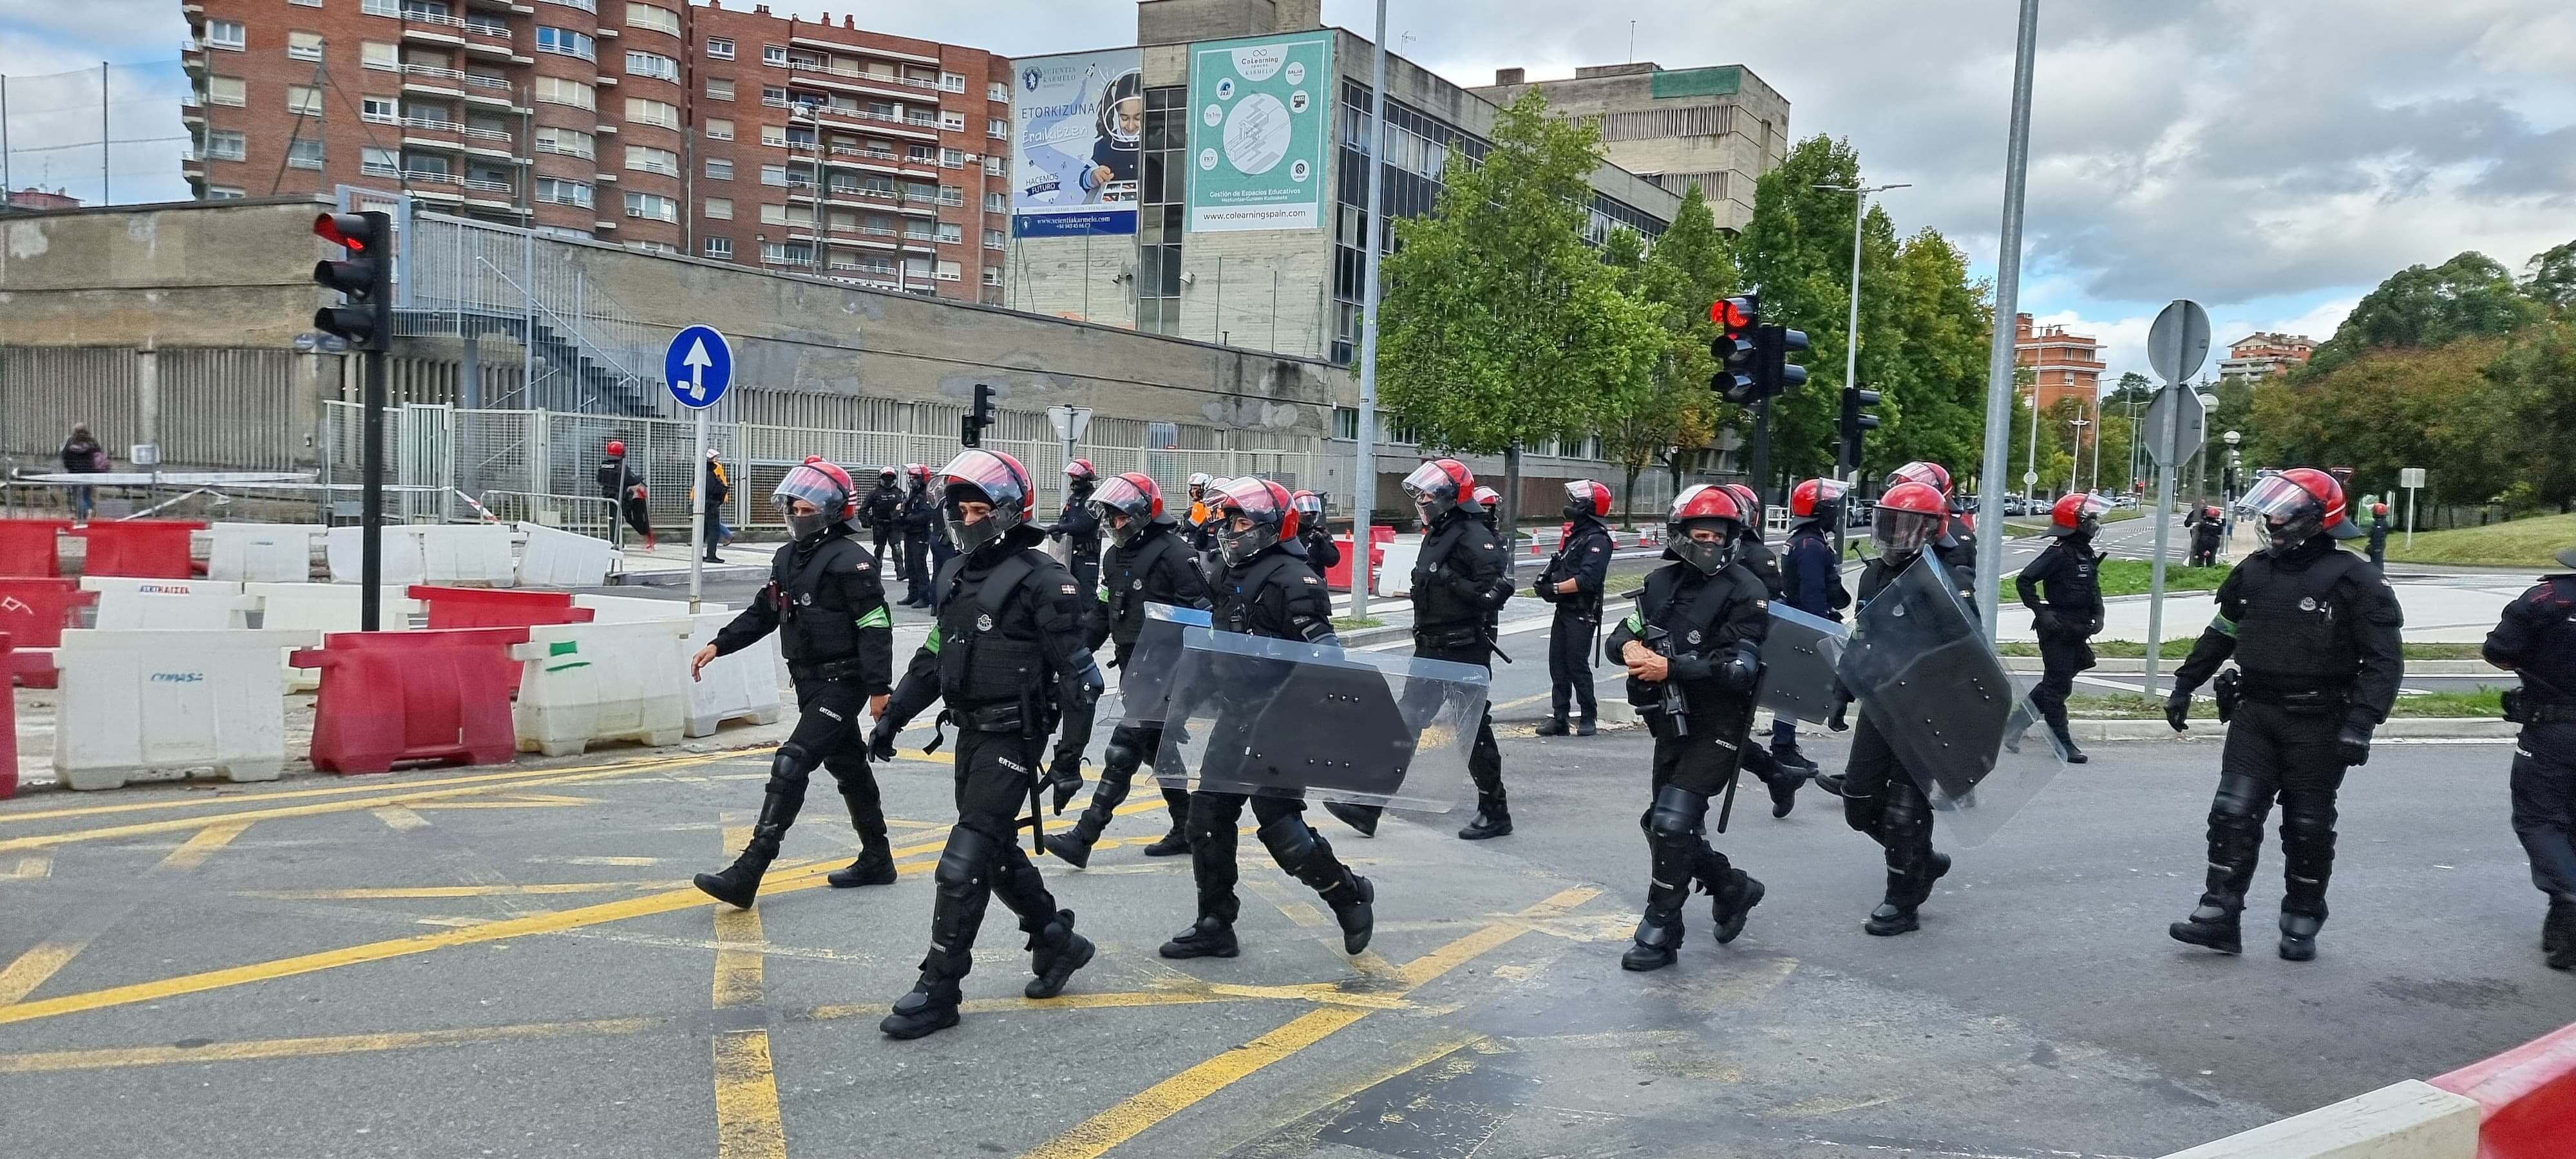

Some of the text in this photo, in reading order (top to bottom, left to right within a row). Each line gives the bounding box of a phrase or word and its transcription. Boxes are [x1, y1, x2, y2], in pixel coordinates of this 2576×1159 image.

[1043, 75, 1076, 83] KARMELO
[1021, 103, 1095, 119] ETORKIZUNA
[1025, 173, 1059, 185] HACEMOS
[1031, 183, 1056, 193] FUTURO
[1241, 189, 1267, 198] Espacios
[1204, 209, 1307, 220] www.colearningspain.com
[1037, 215, 1111, 225] www.scientiakarmelo.com
